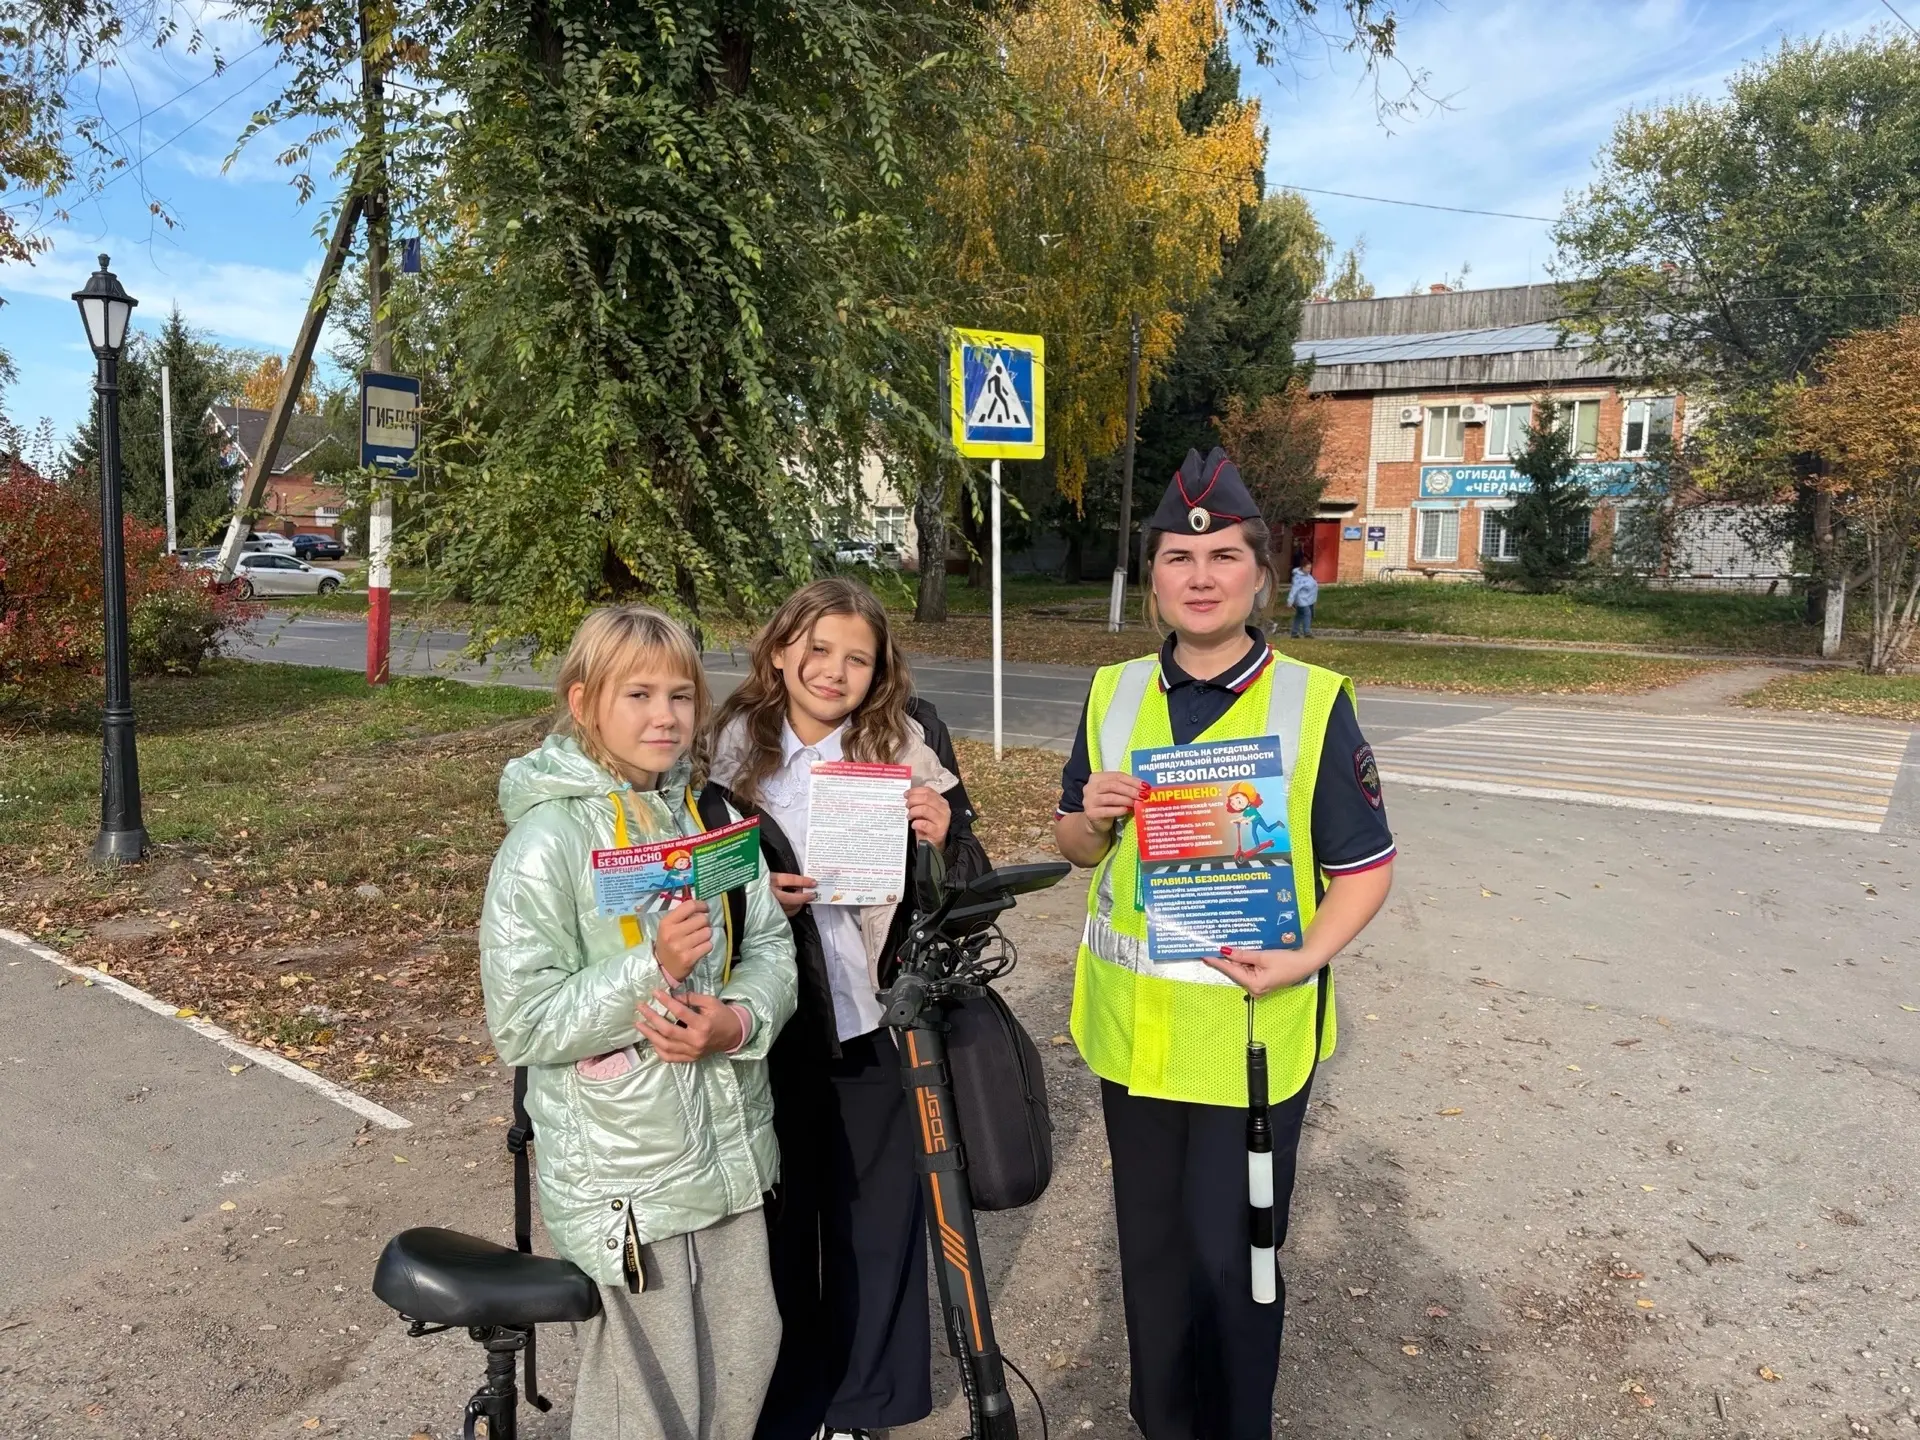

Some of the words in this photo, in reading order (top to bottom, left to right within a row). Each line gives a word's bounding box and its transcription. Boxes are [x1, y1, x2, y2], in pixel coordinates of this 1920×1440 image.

[368, 406, 415, 431] ГИБДД
[1456, 468, 1506, 480] ОГИБДД
[1139, 756, 1212, 771] ИНДИВИДУАЛЬНОЙ
[1213, 752, 1274, 763] МОБИЛЬНОСТИ
[1151, 750, 1200, 762] ДВИГАЙТЕСЬ
[1200, 748, 1212, 756] НА
[1213, 744, 1259, 755] СРЕДСТВАХ
[1156, 764, 1256, 784] БЕЗОПАСНО!
[598, 849, 633, 858] ДВИГАЙТЕСЬ
[643, 843, 674, 852] СРЕДСТВАХ
[598, 852, 662, 868] БЕЗОПАСНО
[1151, 877, 1193, 886] ПРАВИЛА
[1195, 872, 1271, 883] БЕЗОПАСНОСТИ:
